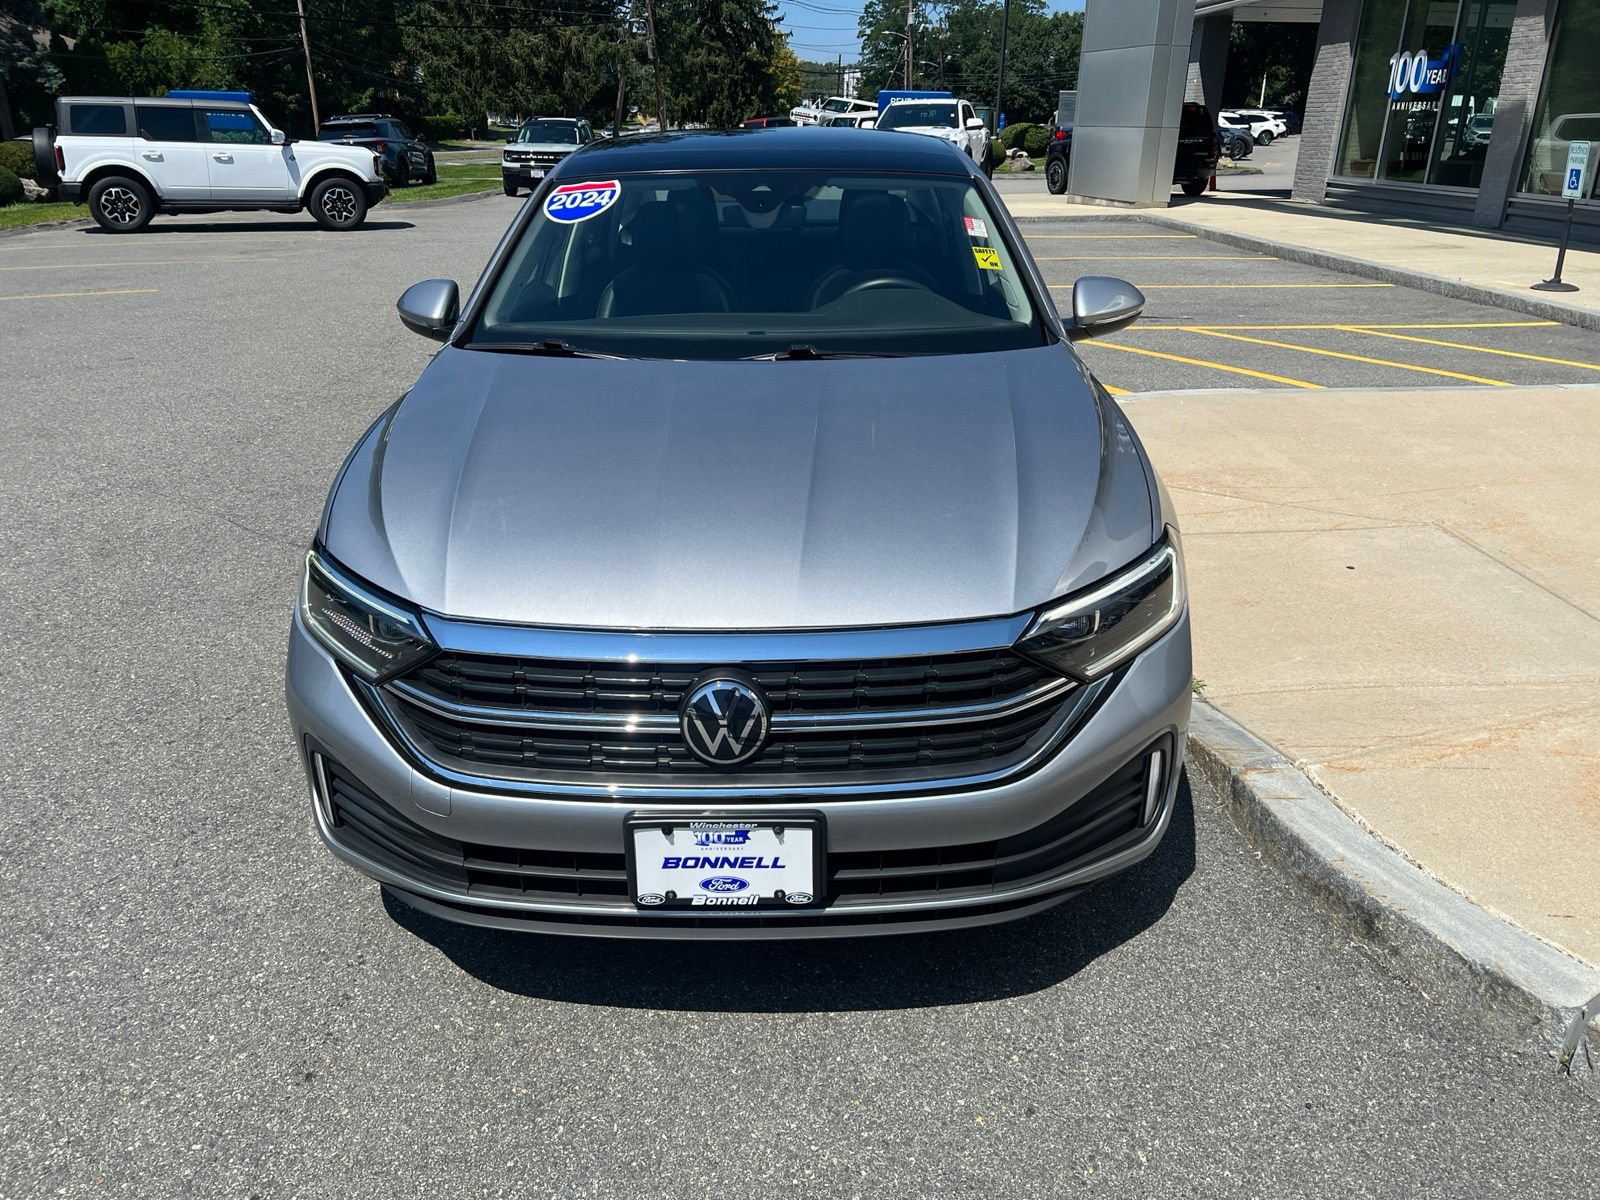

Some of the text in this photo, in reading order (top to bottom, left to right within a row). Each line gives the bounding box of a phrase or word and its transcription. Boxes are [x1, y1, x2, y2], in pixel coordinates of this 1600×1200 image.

[1388, 50, 1427, 93] 100
[548, 190, 611, 210] 2024
[695, 831, 726, 845] 100
[662, 857, 786, 869] BONNELL
[708, 878, 740, 891] Ford
[691, 894, 760, 906] Bonnell
